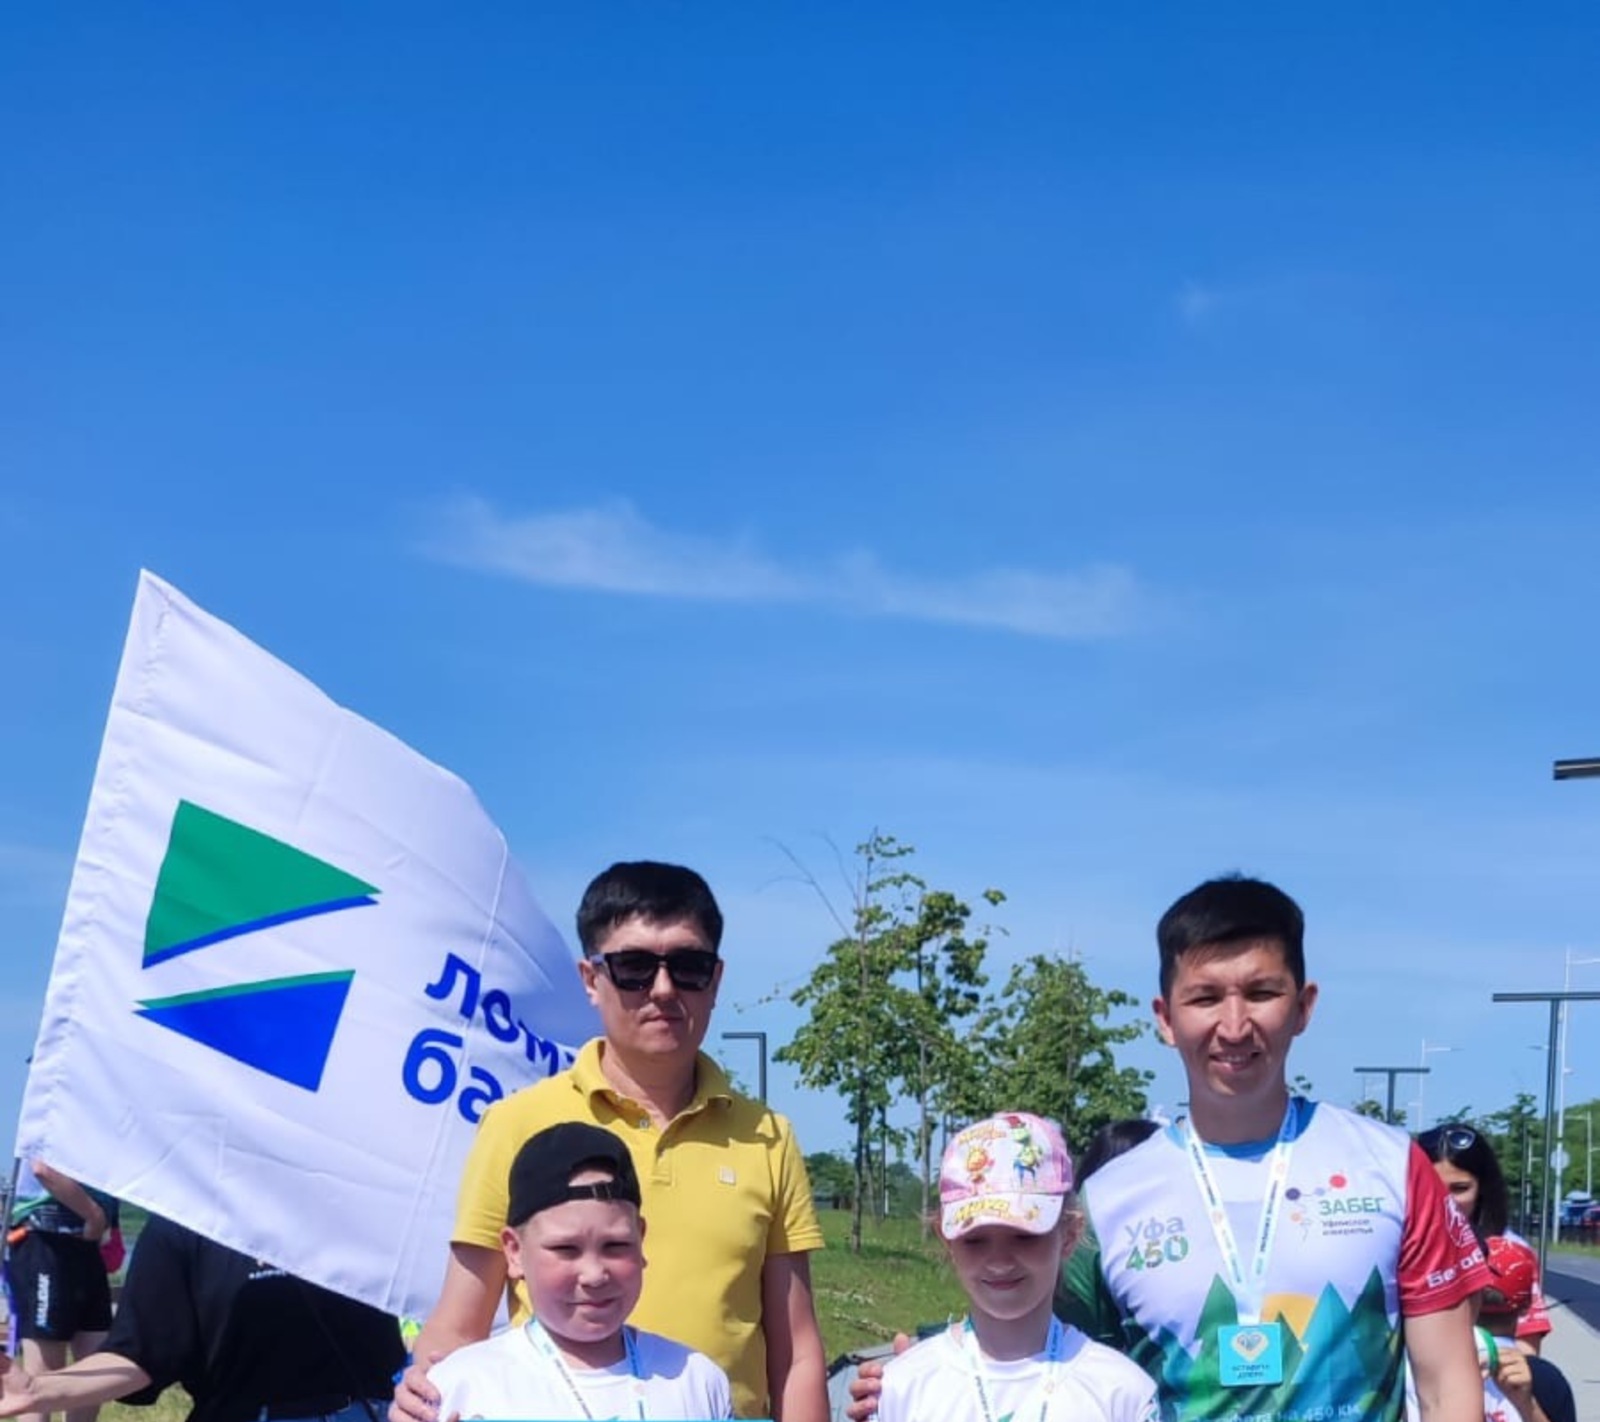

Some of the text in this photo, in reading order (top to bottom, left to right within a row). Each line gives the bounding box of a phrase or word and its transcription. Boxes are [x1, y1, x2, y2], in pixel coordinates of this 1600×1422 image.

[424, 952, 575, 1076] лом
[402, 1028, 503, 1124] ба
[1318, 1197, 1384, 1216] ЗАБЕГ
[1124, 1216, 1185, 1243] Уфа
[1125, 1235, 1189, 1271] 450
